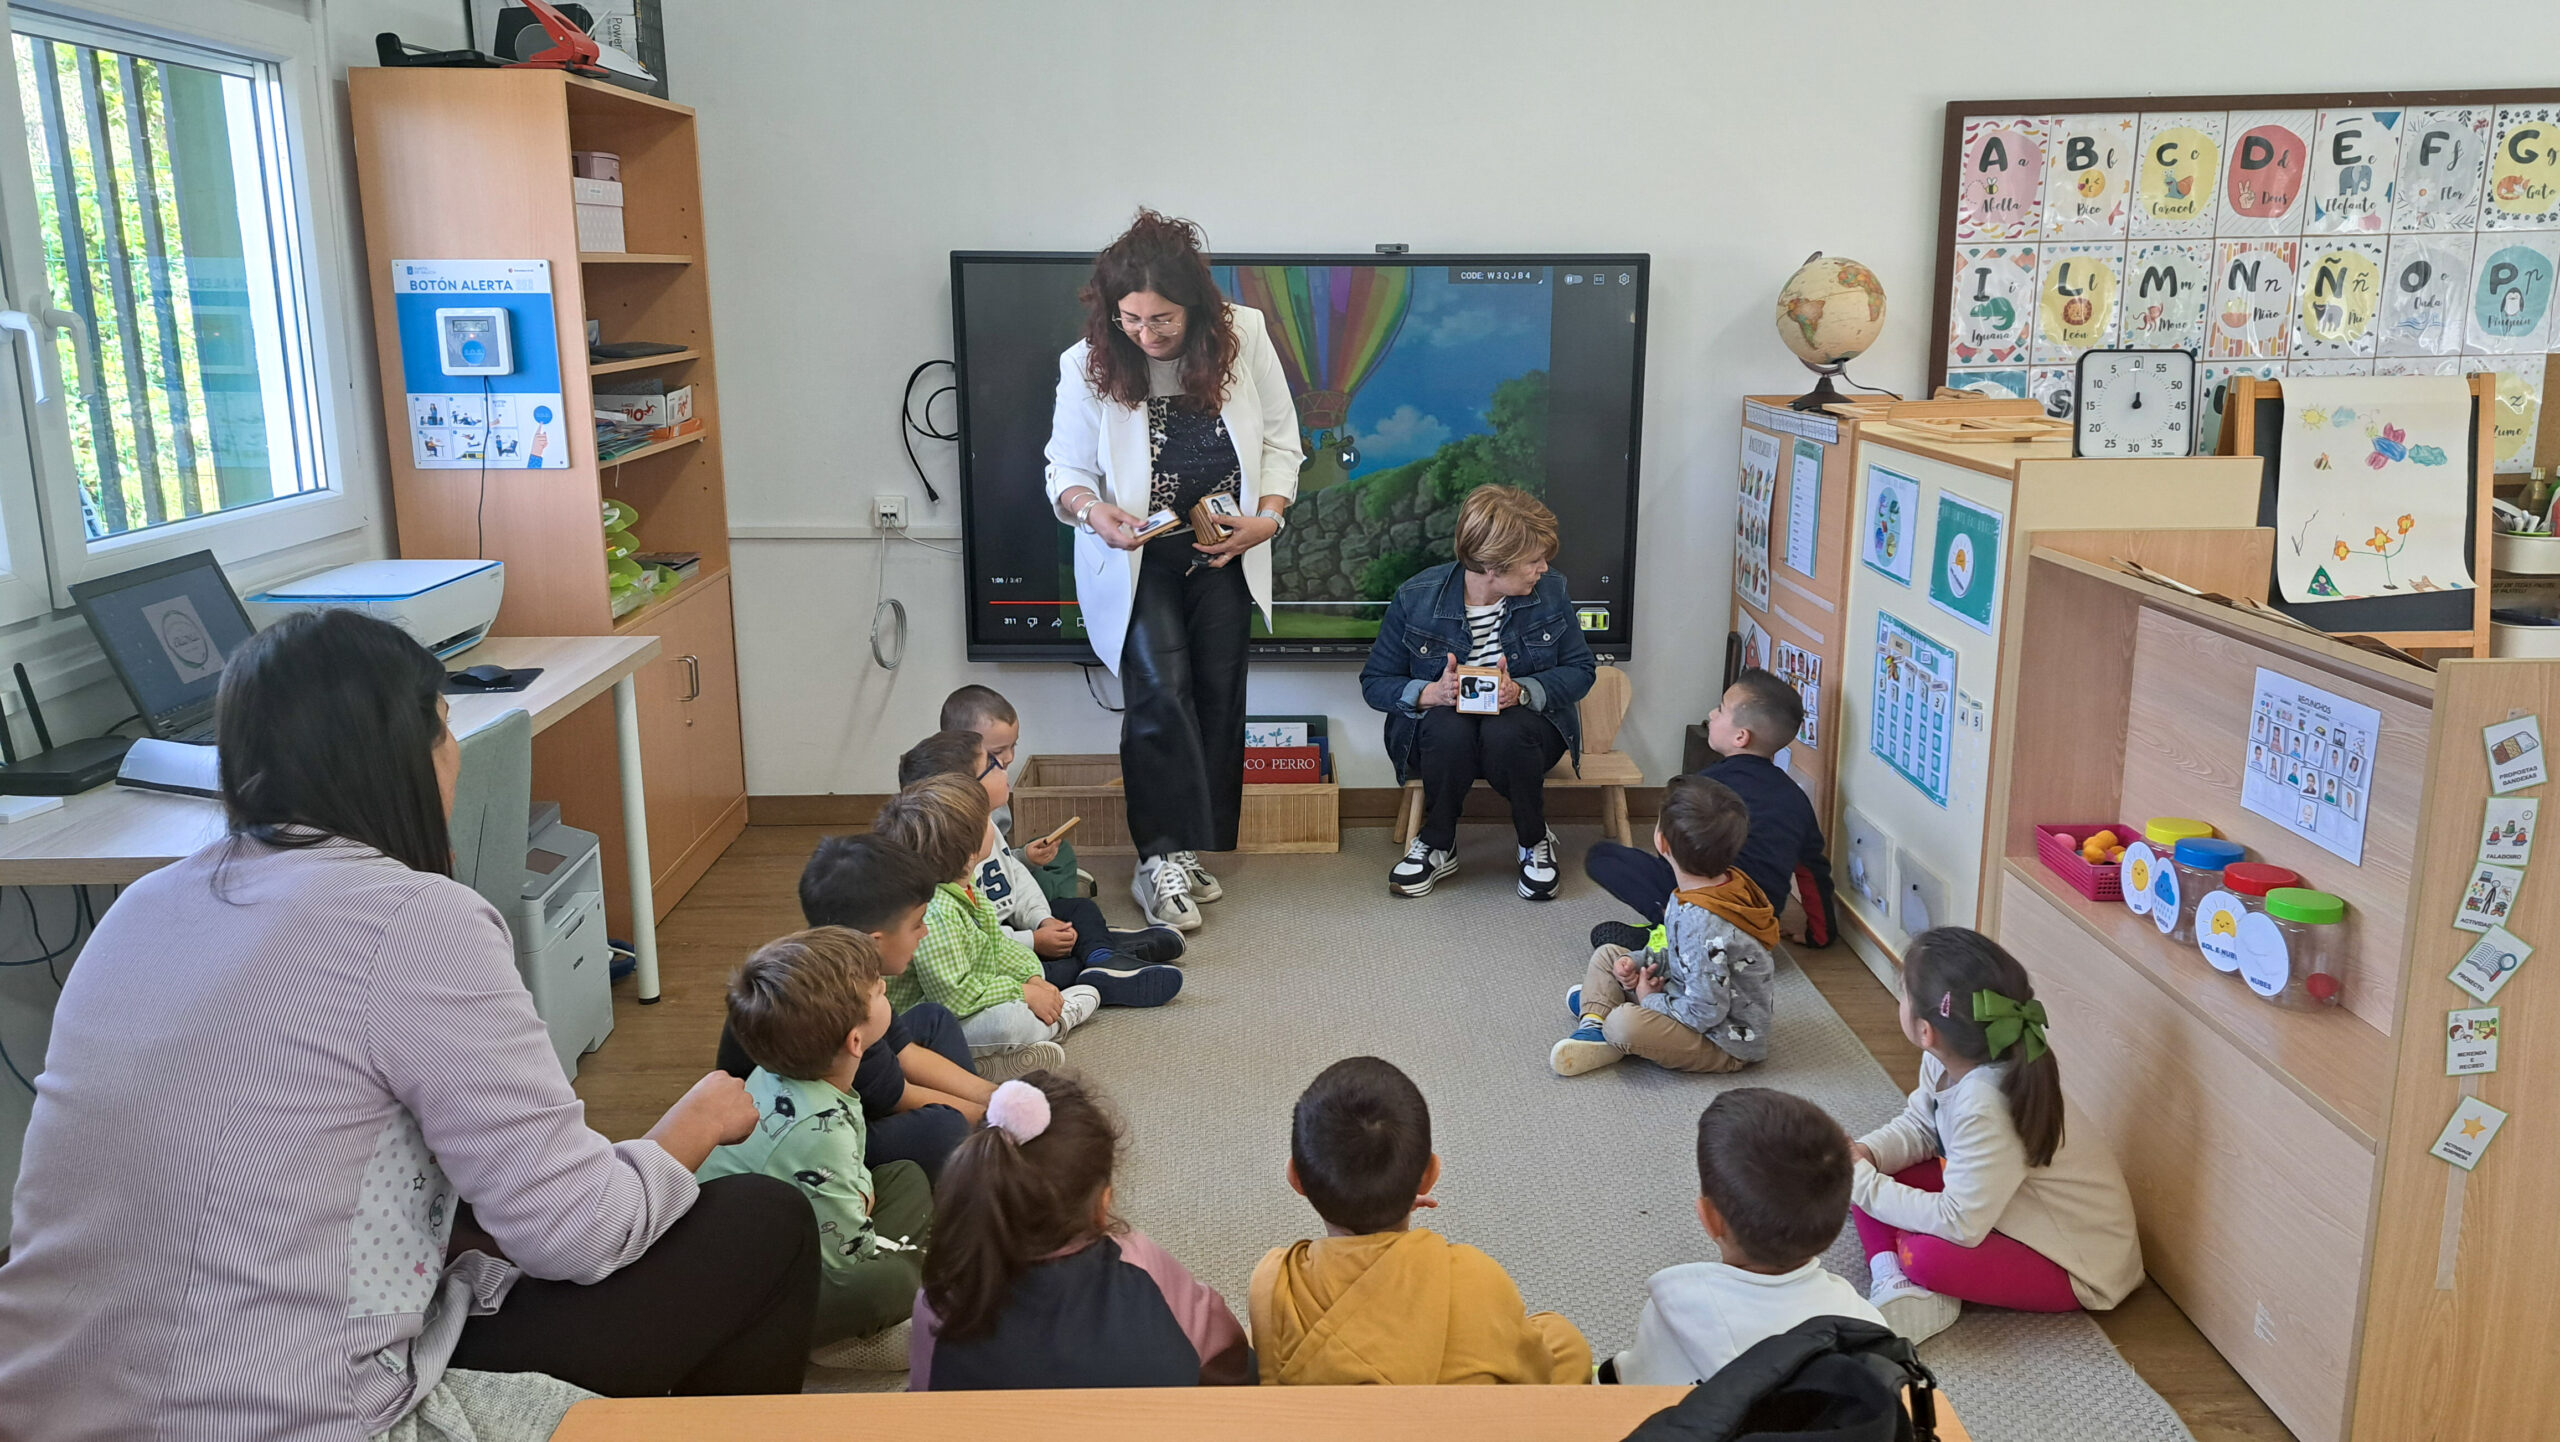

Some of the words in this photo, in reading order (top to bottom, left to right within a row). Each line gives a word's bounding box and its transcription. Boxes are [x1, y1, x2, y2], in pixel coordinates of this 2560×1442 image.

[612, 18, 622, 48] Power
[1979, 136, 2008, 172] A
[2018, 158, 2029, 167] a
[2066, 136, 2098, 171] B
[2106, 148, 2119, 168] b
[2156, 142, 2178, 166] C
[2190, 150, 2200, 160] c
[2240, 136, 2274, 170] D
[2277, 150, 2290, 168] d
[2332, 130, 2362, 166] E
[2368, 154, 2377, 164] e
[2420, 131, 2450, 166] F
[2447, 140, 2464, 171] f
[2508, 130, 2540, 164] G
[2441, 186, 2466, 200] Flor
[2526, 183, 2556, 198] Gato
[1981, 197, 2022, 213] Abella
[2078, 202, 2102, 216] Bico
[2152, 202, 2196, 214] Caracol
[2325, 197, 2376, 214] Elefante
[2058, 262, 2084, 296] L
[2088, 274, 2098, 290] l
[2139, 266, 2178, 298] M
[2180, 280, 2195, 290] m
[2228, 259, 2261, 292] N
[2264, 278, 2282, 292] n
[2315, 257, 2348, 298] Ñ
[2352, 272, 2370, 292] ñ
[2400, 260, 2432, 293] O
[2440, 273, 2450, 281] o
[2490, 262, 2518, 294] P
[2524, 268, 2544, 295] p
[410, 277, 456, 290] BOTÓN
[462, 280, 512, 290] ALERTA
[1973, 268, 1992, 302] I
[2008, 281, 2017, 293] i
[2414, 294, 2442, 310] Onda
[2254, 307, 2280, 322] Niño
[2158, 318, 2188, 332] Mono
[1971, 329, 2010, 346] Iguana
[2111, 364, 2116, 373] 5
[2134, 360, 2140, 368] 0
[2156, 364, 2166, 372] 55
[2094, 380, 2102, 388] 10
[2170, 380, 2182, 390] 50
[2047, 390, 2073, 418] S
[2086, 402, 2096, 410] 15
[2174, 401, 2186, 410] 45
[2089, 424, 2101, 432] 20
[2168, 422, 2180, 431] 40
[2104, 440, 2116, 448] 25
[2128, 444, 2140, 452] 30
[2152, 439, 2163, 448] 35
[1244, 759, 1264, 770] CO
[1272, 758, 1315, 770] PERRO
[2499, 766, 2538, 779] PROPOSTAS
[2201, 942, 2214, 952] SOL
[2250, 976, 2272, 990] NUBES
[2457, 972, 2484, 992] PROXECTO
